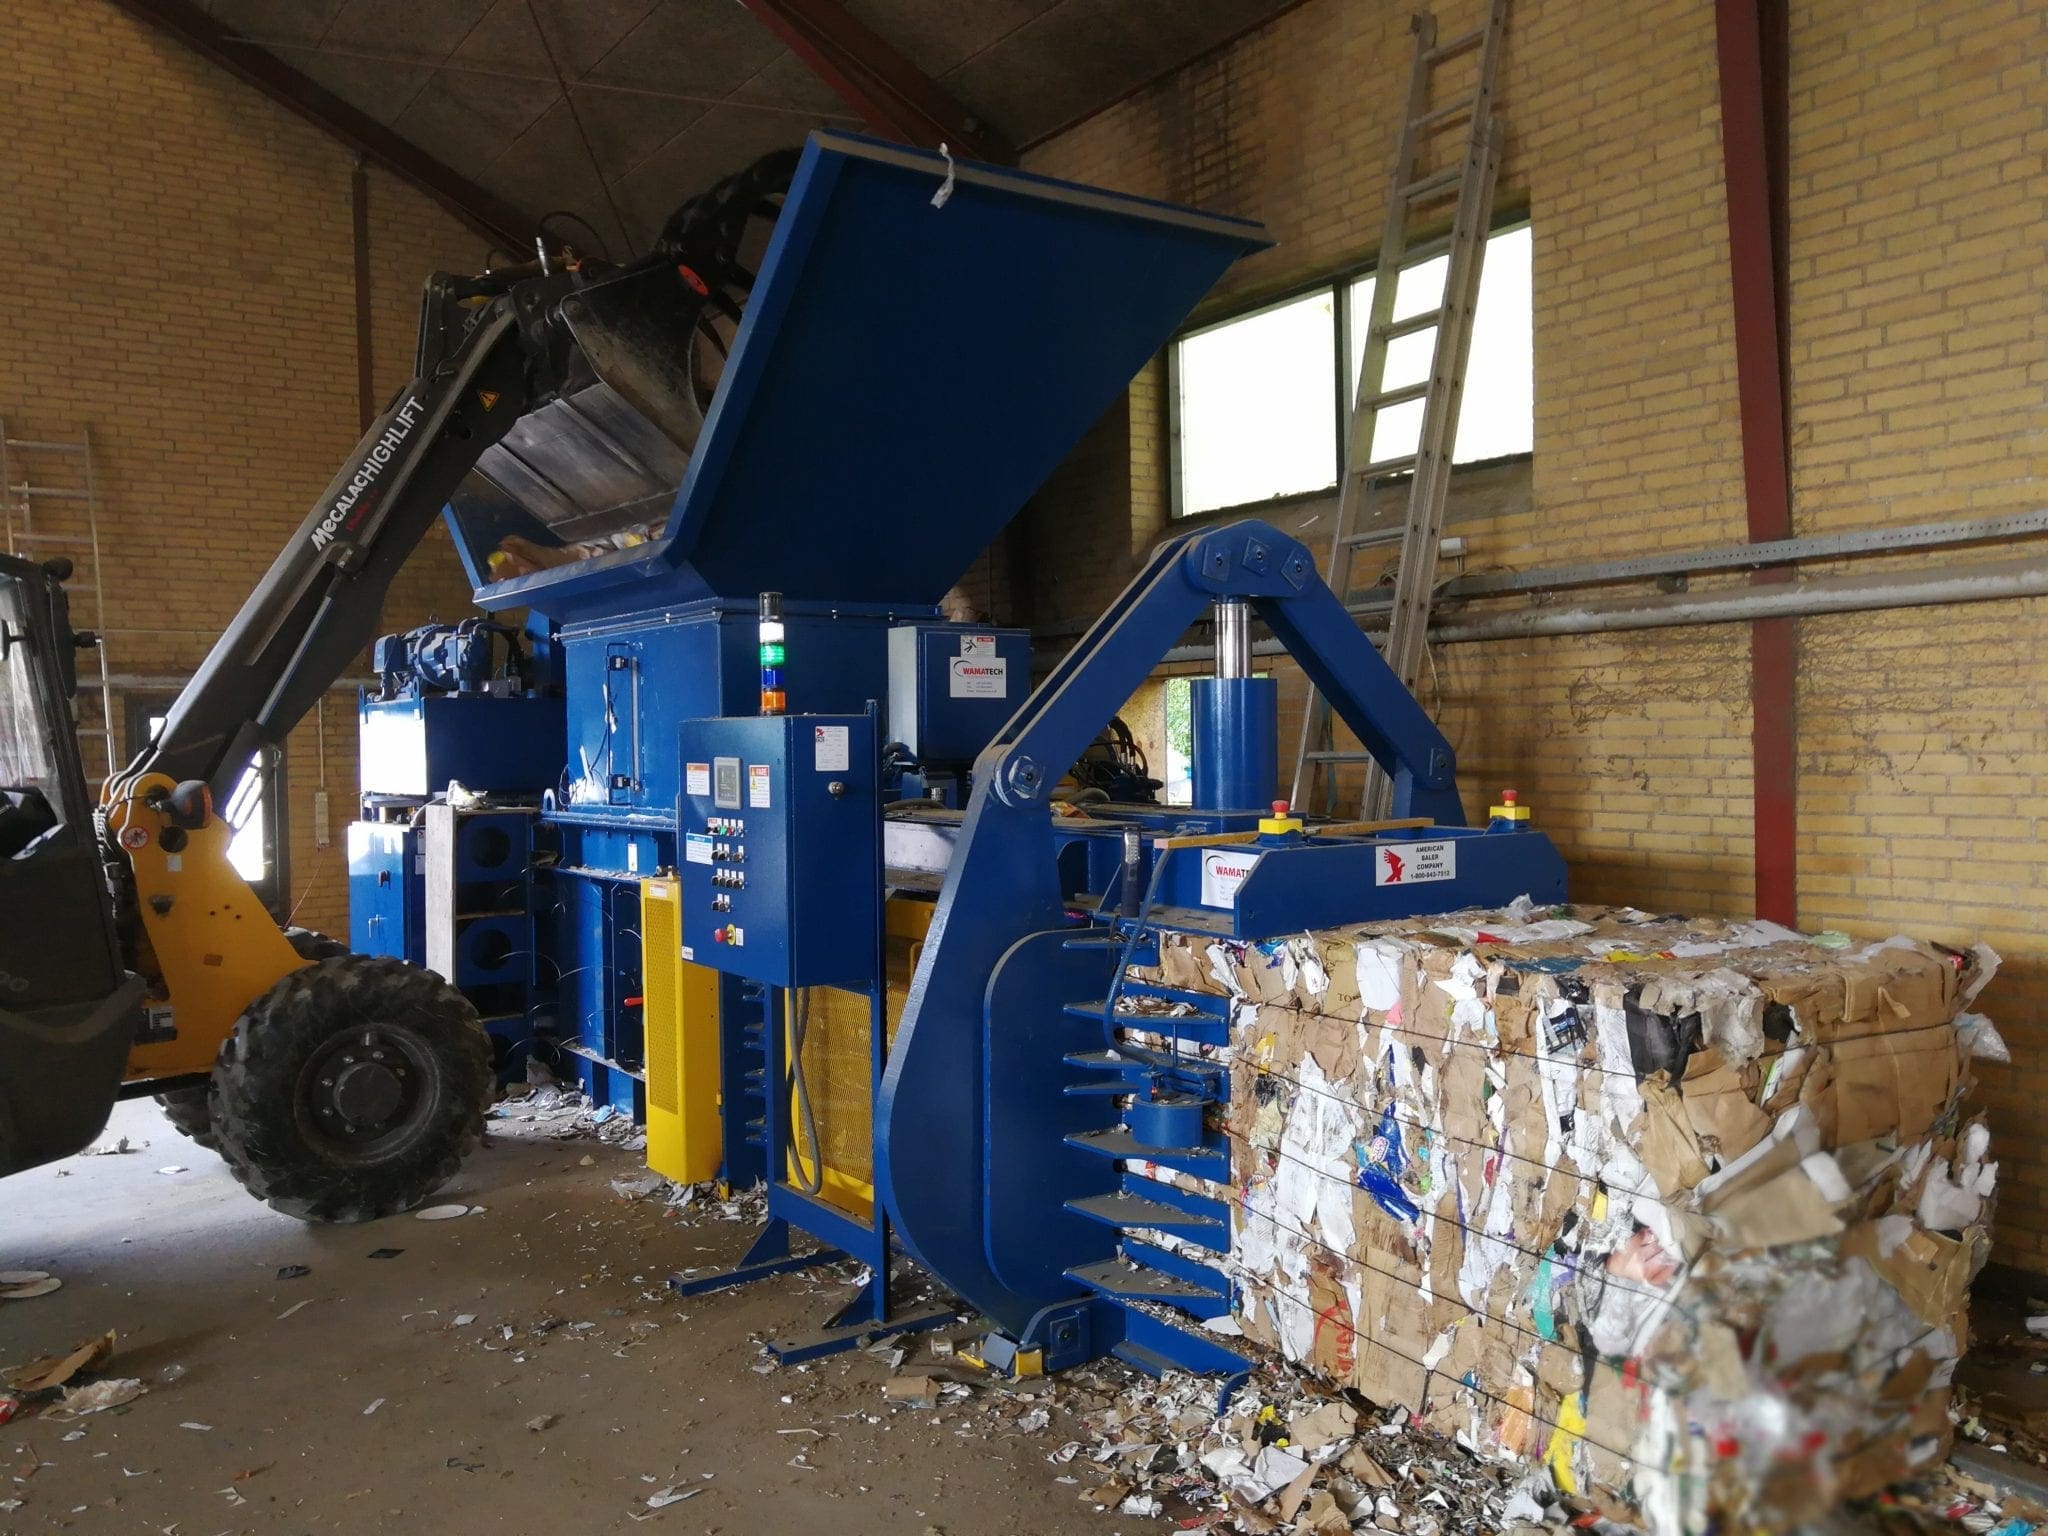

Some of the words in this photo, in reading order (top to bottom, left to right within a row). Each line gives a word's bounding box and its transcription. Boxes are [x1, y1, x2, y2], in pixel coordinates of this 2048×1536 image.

[963, 667, 1003, 676] WAMATECH
[1416, 845, 1444, 853] AMERICAN
[1421, 854, 1439, 862] BALER
[1416, 863, 1444, 871] COMPANY
